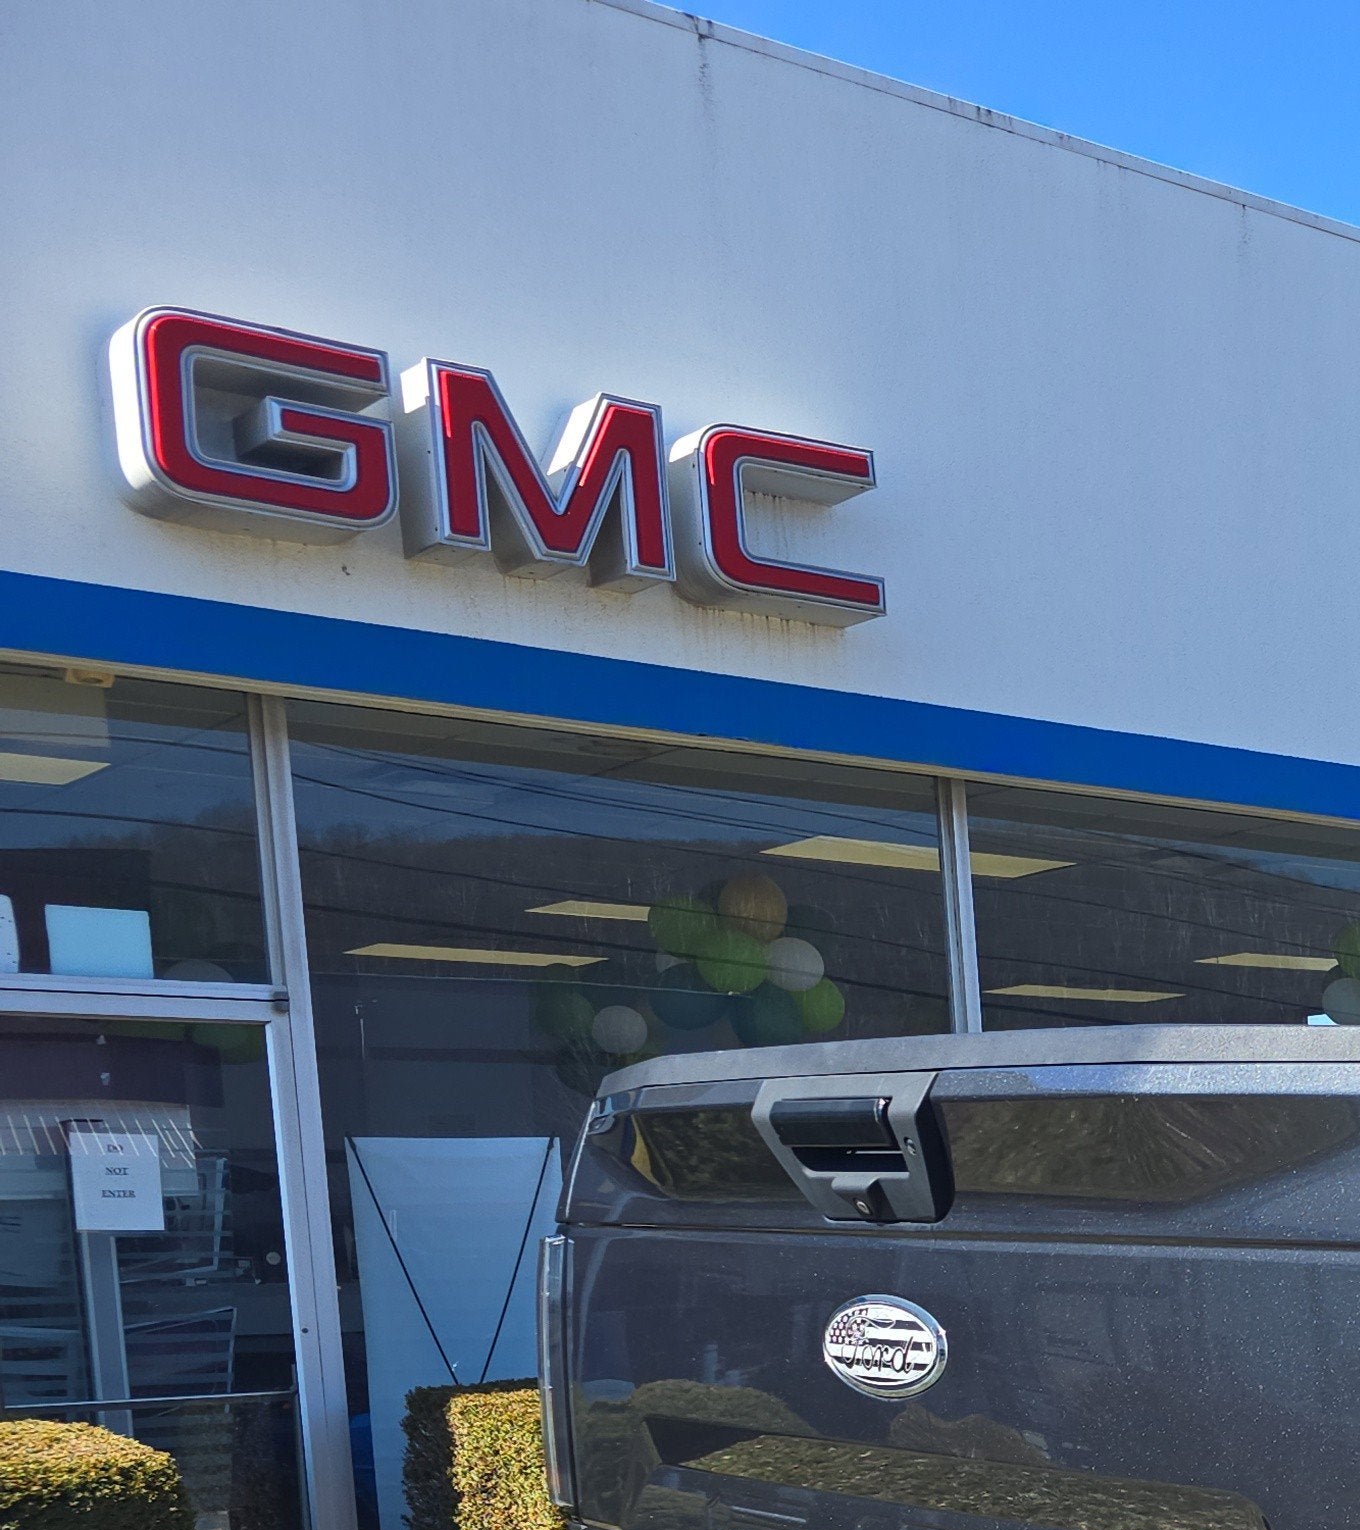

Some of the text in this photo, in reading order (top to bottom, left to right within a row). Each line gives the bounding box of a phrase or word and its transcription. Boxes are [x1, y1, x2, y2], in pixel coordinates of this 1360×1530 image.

[113, 304, 886, 626] GMC
[107, 1144, 123, 1153] DO
[105, 1167, 129, 1175] NOT
[101, 1190, 136, 1198] ENTER
[841, 1314, 914, 1375] Ford
